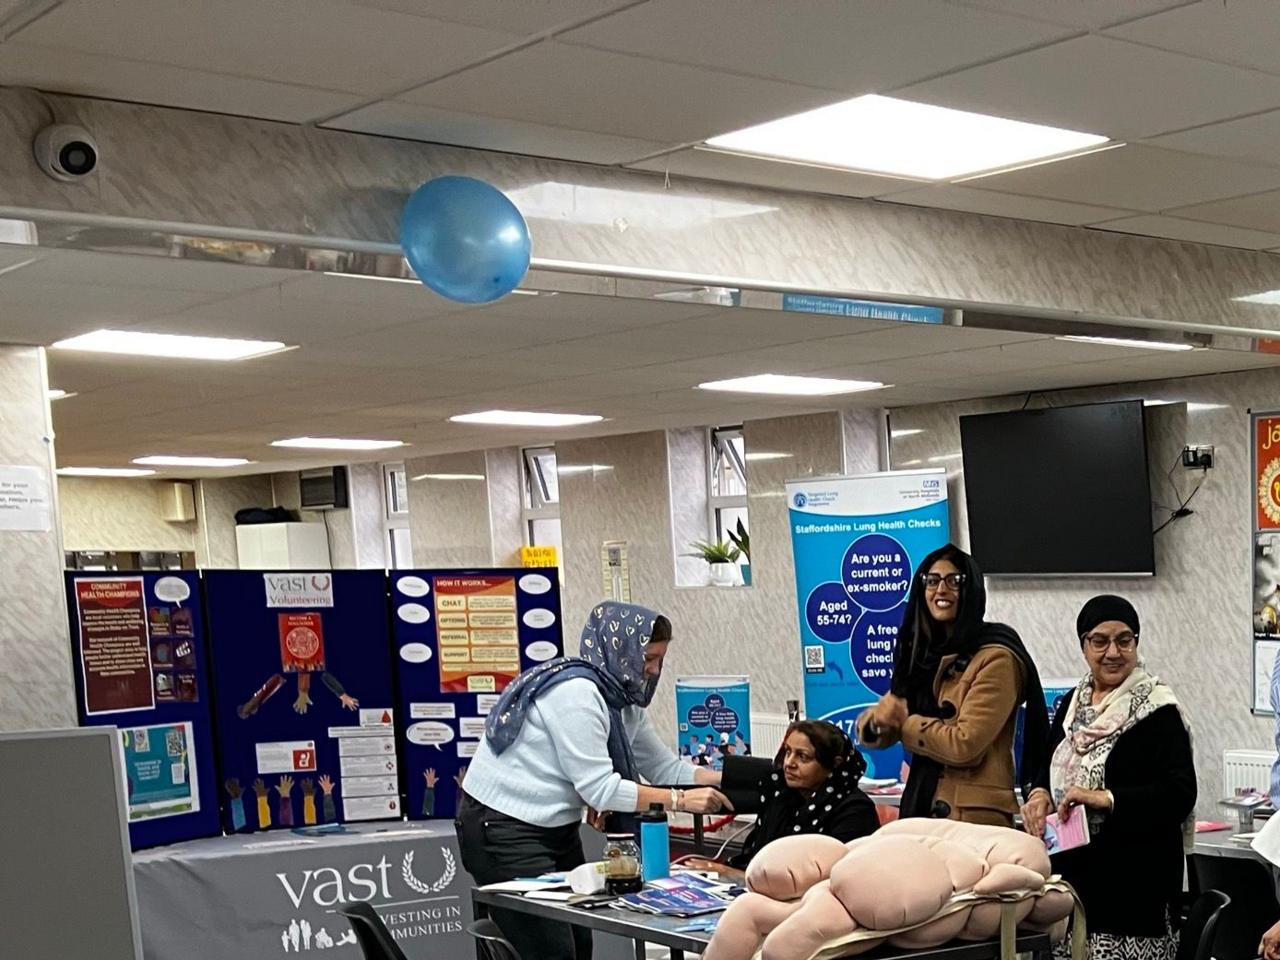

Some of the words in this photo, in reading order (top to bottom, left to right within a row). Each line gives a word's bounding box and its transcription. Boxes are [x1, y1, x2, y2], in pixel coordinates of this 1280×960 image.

[796, 523, 851, 534] Staffordshire
[854, 522, 876, 532] Lung
[878, 520, 906, 530] Health
[908, 518, 941, 528] Checks
[851, 554, 870, 564] Are
[872, 555, 894, 566] you
[894, 554, 901, 562] a
[851, 566, 889, 578] current
[892, 568, 903, 576] or
[848, 580, 908, 593] ex-smoker?
[80, 590, 104, 599] HEALTH
[820, 600, 848, 613] Aged
[817, 614, 852, 626] 55-74?
[867, 625, 876, 635] A
[878, 624, 898, 634] free
[867, 639, 891, 650] lung
[862, 669, 887, 678] save
[276, 854, 392, 909] vast
[380, 906, 442, 926] VESTING
[446, 905, 461, 917] IN
[389, 920, 462, 940] MUNITIES
